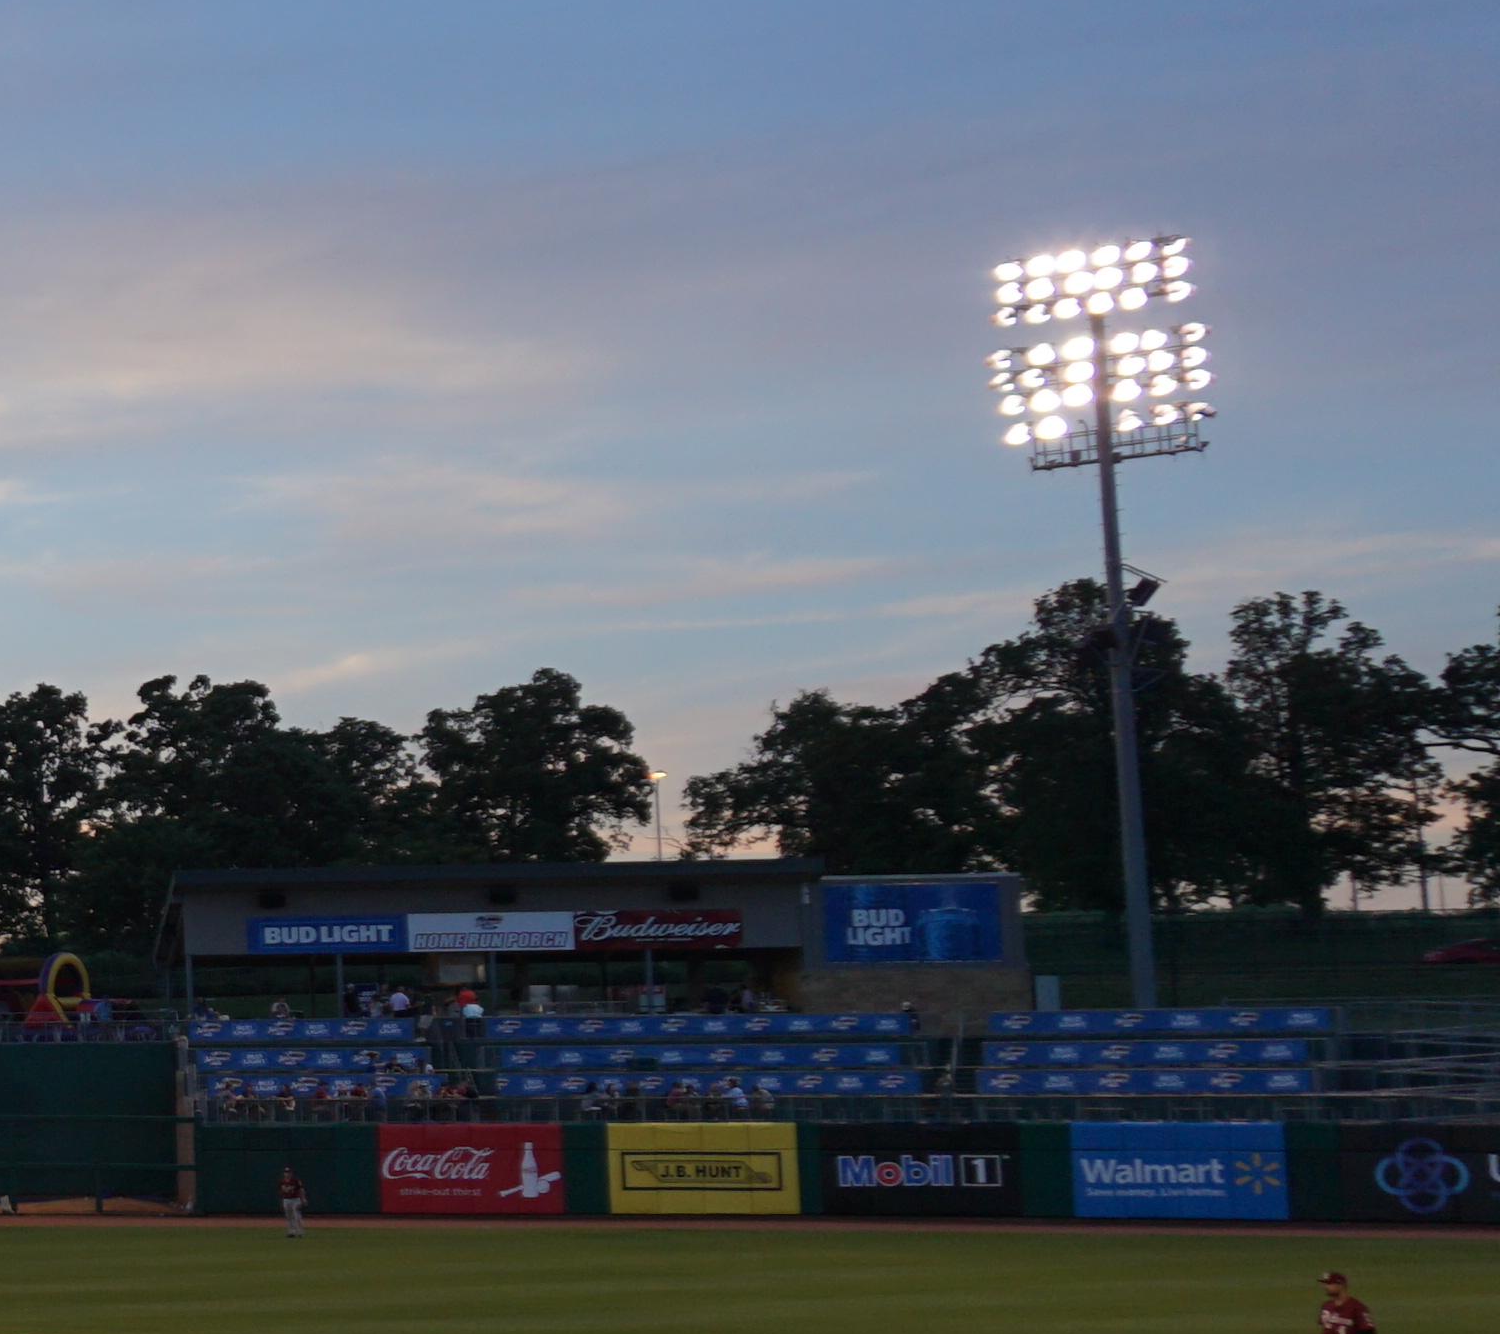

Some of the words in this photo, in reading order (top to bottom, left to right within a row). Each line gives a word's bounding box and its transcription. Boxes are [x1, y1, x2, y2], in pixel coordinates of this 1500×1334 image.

[853, 908, 905, 927] BUD
[264, 926, 318, 944] BUD
[321, 924, 393, 943] LIGHT
[577, 913, 742, 943] Budweiser
[847, 927, 911, 946] LIGHT
[414, 933, 465, 949] HOME
[467, 933, 504, 948] RUN
[506, 932, 568, 948] PORCH
[382, 1146, 495, 1181] Coca-Cola
[659, 1165, 689, 1179] J.B.
[696, 1164, 742, 1179] HUNT
[838, 1155, 954, 1188] Mobil
[1080, 1157, 1225, 1185] Walmart
